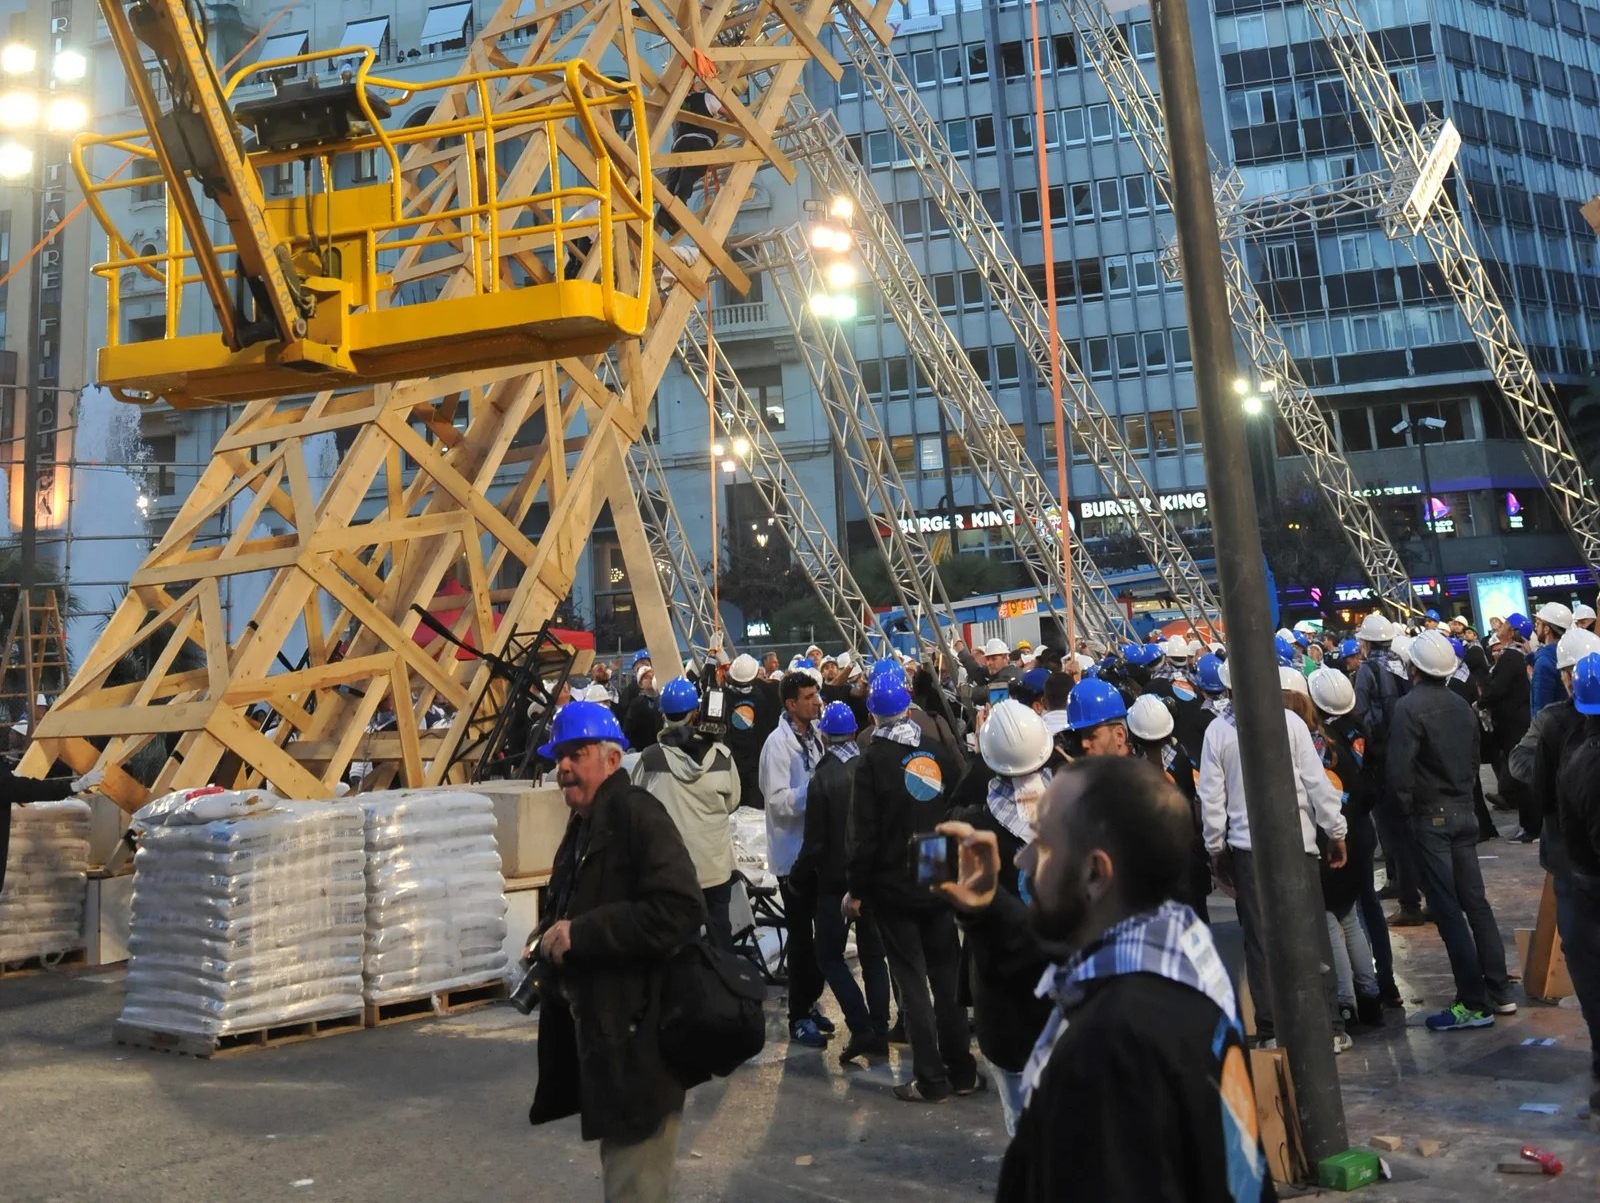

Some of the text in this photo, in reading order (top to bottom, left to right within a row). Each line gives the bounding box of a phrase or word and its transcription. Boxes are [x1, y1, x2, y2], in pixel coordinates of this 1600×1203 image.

[1081, 492, 1206, 518] BURGER KING
[898, 514, 964, 534] BURGER
[971, 509, 1015, 528] KING
[1529, 575, 1555, 587] TACO
